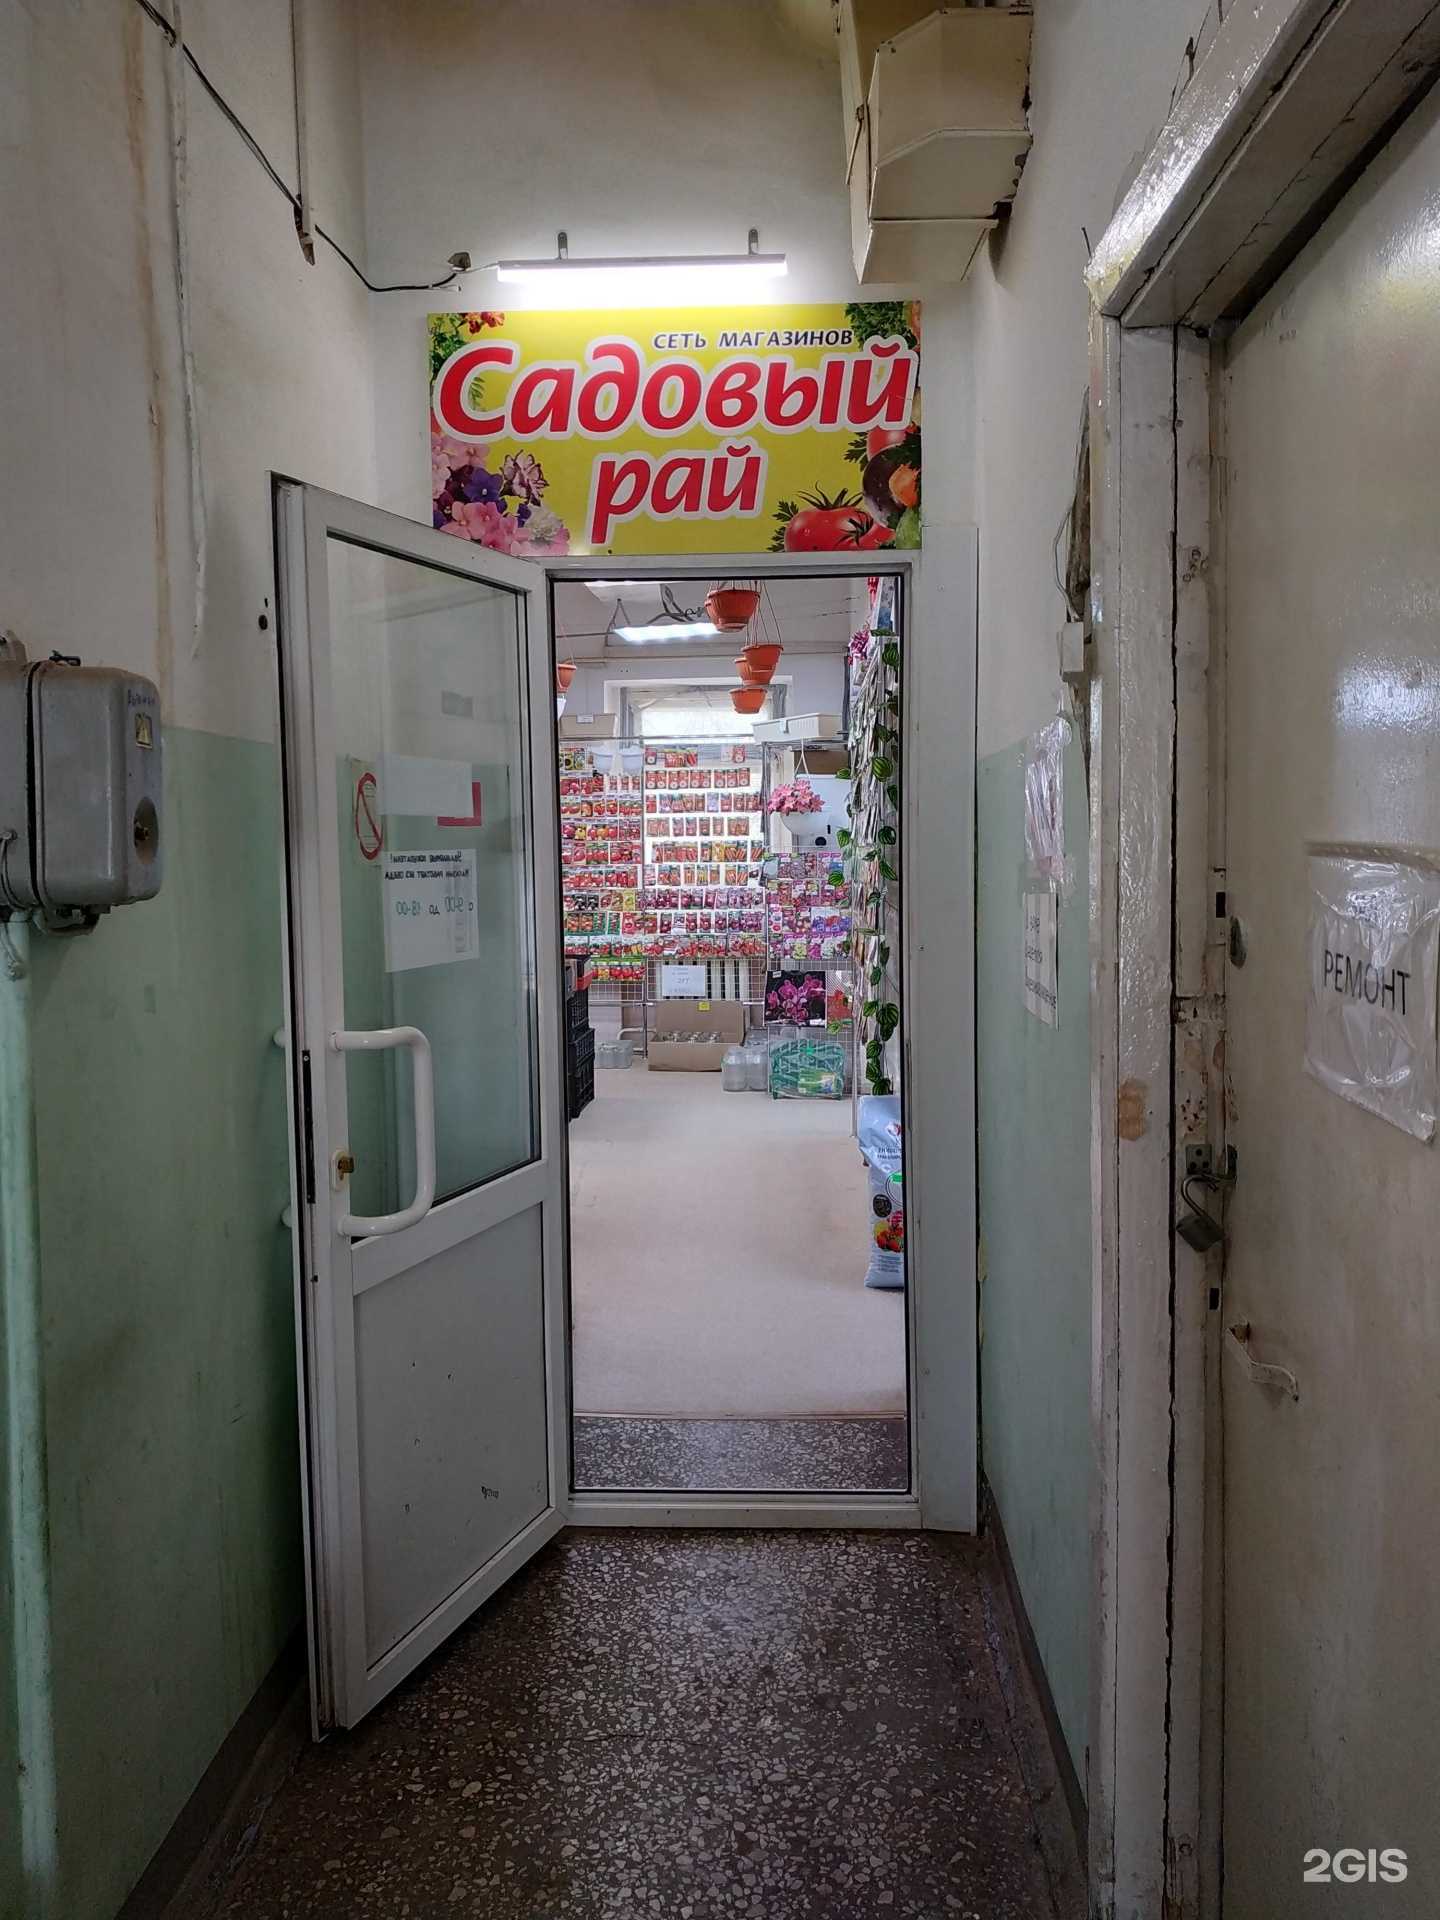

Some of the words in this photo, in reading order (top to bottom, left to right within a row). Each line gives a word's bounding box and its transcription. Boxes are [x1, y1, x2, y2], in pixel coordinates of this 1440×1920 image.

[653, 332, 707, 350] СЕТЬ
[718, 329, 853, 348] МАГАЗИНОВ
[439, 341, 912, 436] Садовый
[590, 444, 761, 544] рай
[1322, 949, 1412, 1016] РЕМОНТ
